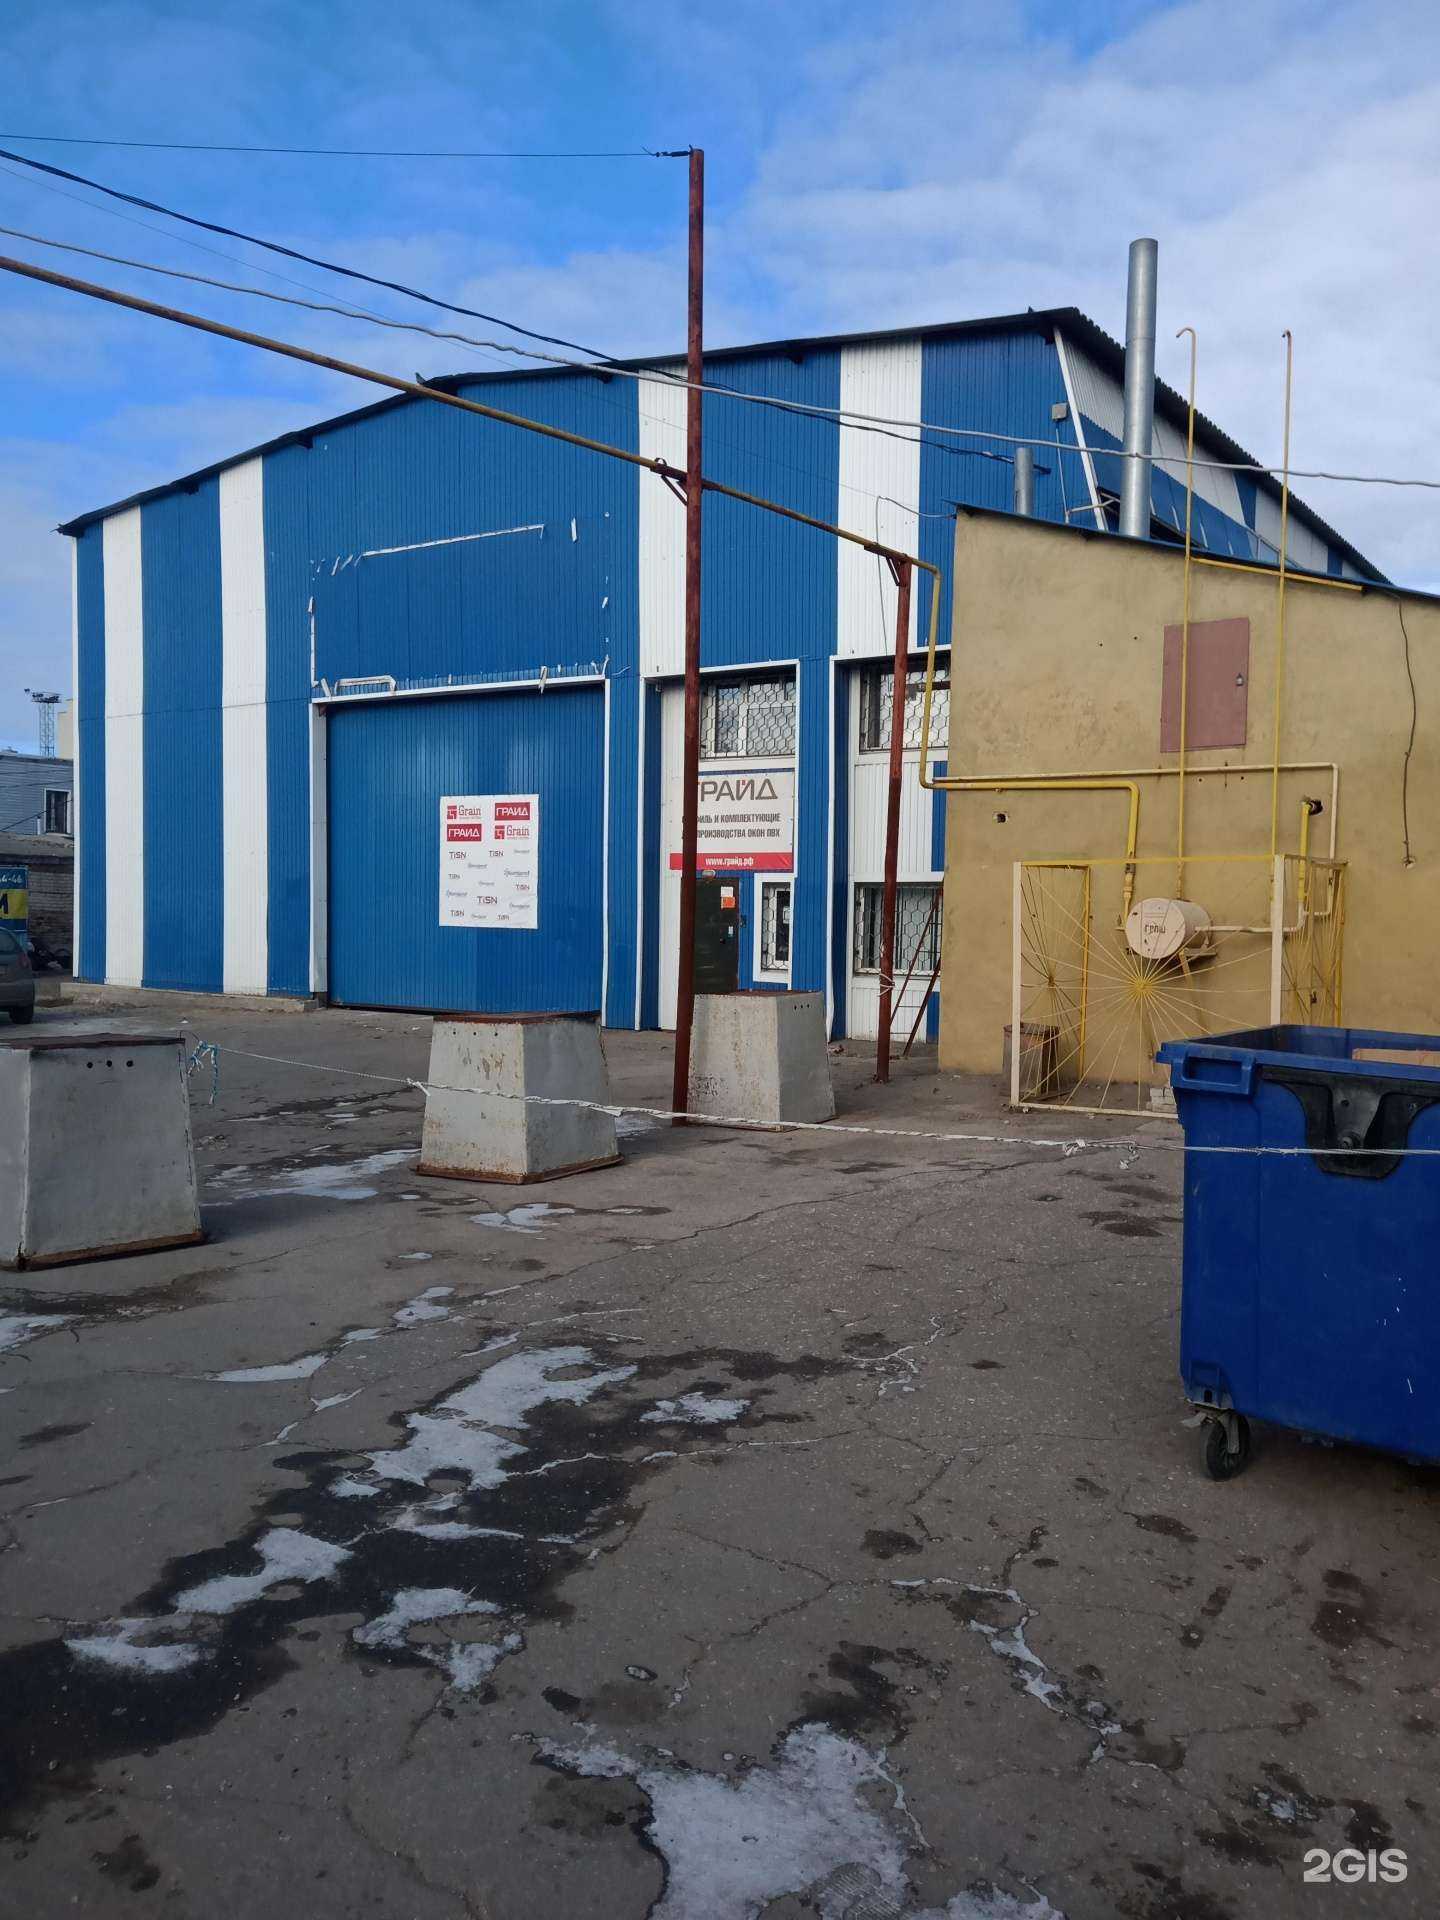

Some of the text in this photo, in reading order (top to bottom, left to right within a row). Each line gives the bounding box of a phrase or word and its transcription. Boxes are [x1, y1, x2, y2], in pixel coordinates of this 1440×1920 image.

[698, 778, 778, 802] РАЙД
[459, 805, 481, 815] Grain
[720, 812, 782, 823] КОМПЛЕКТУЮЩИЕ
[507, 825, 529, 836] Grain
[747, 828, 766, 838] ОКОН
[767, 828, 780, 837] ПВХ
